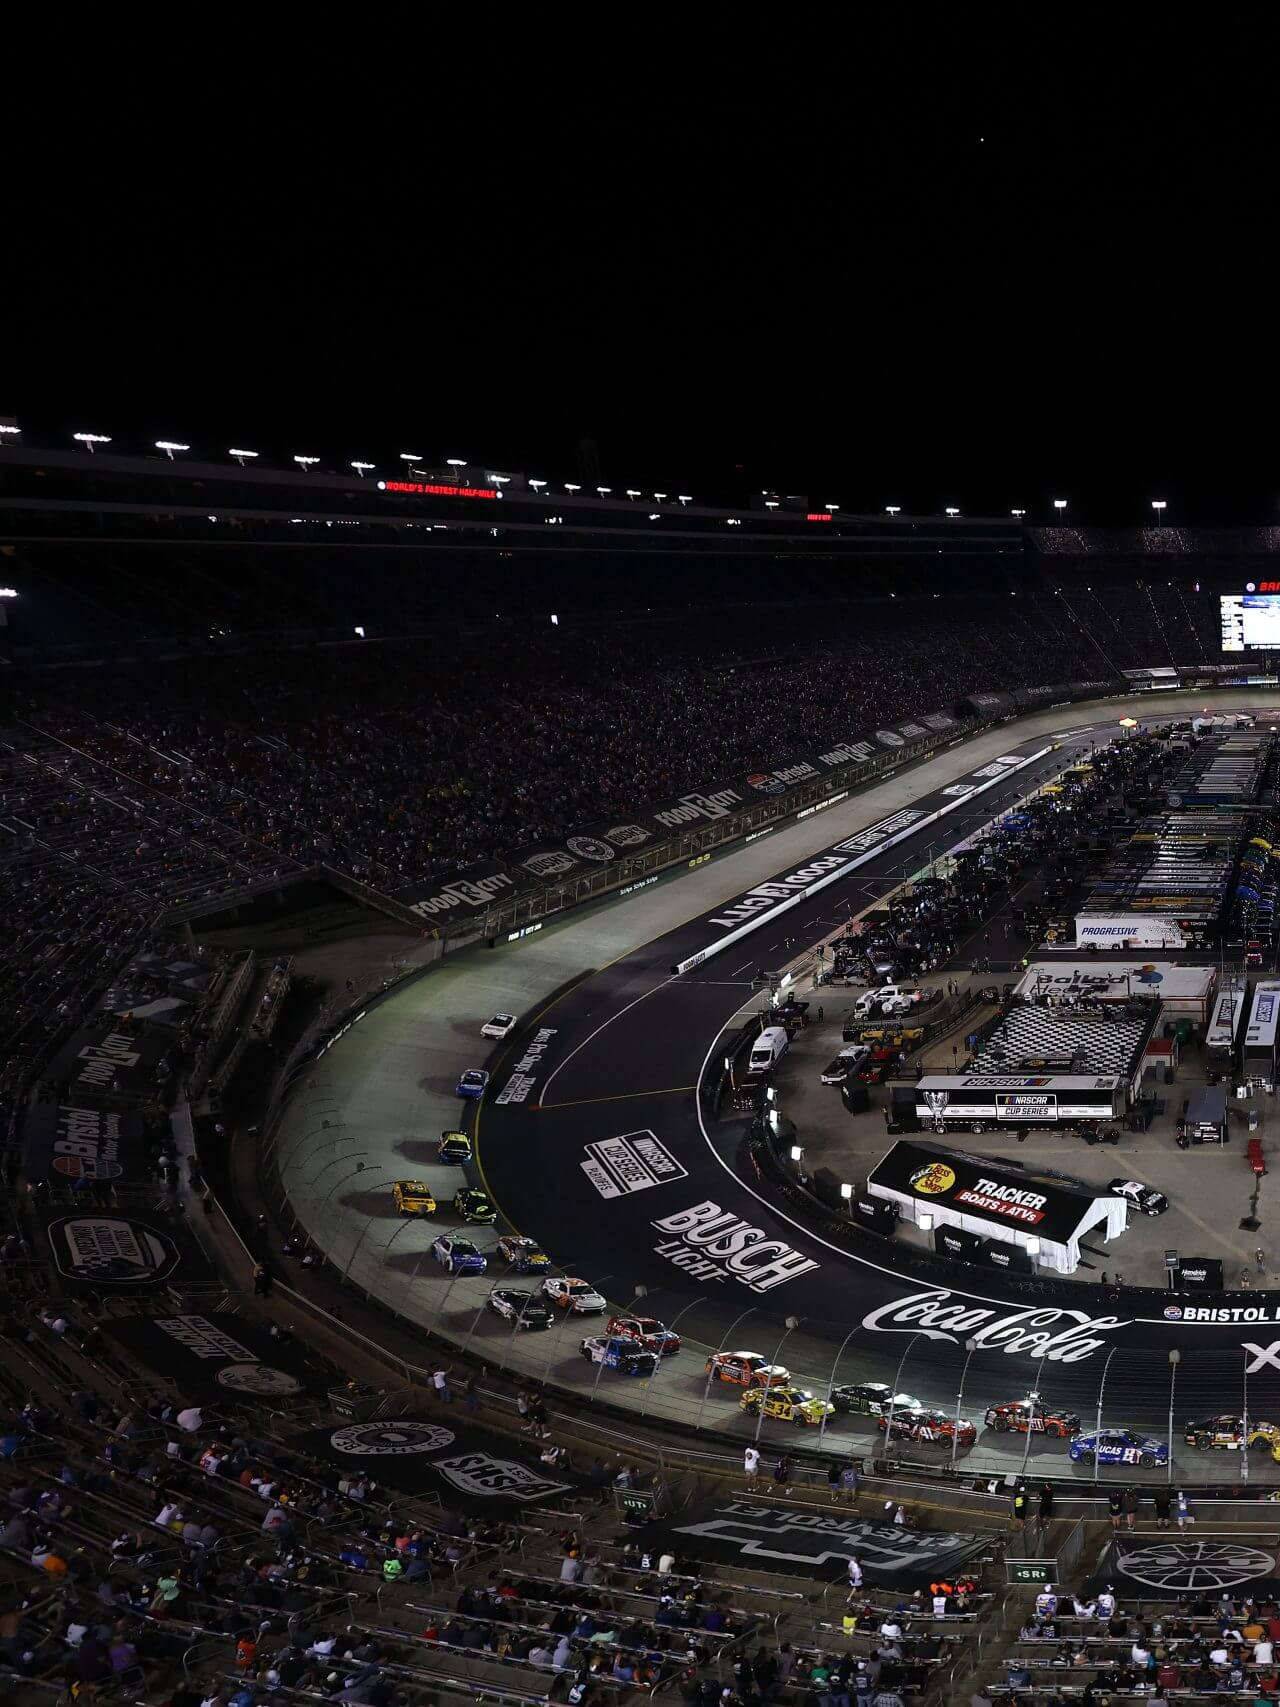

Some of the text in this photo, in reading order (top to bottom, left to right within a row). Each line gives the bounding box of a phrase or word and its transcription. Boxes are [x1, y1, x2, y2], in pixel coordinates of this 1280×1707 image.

[386, 481, 496, 499] WORLD'S FASTEST HALF-MILE
[772, 761, 815, 782] Bristol
[653, 788, 743, 827] FOOD CITY
[407, 872, 514, 918] FOOD CITY
[708, 856, 848, 928] FOOD CITY
[1082, 927, 1139, 935] PROGRESSIVE
[78, 1060, 116, 1087] FOOD
[1005, 1107, 1049, 1115] CUP SERIES
[1014, 1096, 1048, 1105] NASCAR
[56, 1105, 100, 1158] Bristol
[603, 1145, 648, 1182] CUP SERIES
[633, 1139, 677, 1174] NASCAR
[588, 1167, 613, 1191] PLAYOFFS
[927, 1172, 942, 1183] Pro
[934, 1163, 951, 1178] Bass
[920, 1180, 945, 1193] Shops
[971, 1178, 1048, 1210] TRACKER
[959, 1191, 1000, 1212] BOATS
[1006, 1206, 1037, 1222] ATVs
[650, 1200, 821, 1293] BUSCH
[653, 1241, 730, 1281] LIGHT
[1181, 1268, 1207, 1277] Hendrick
[1182, 1306, 1270, 1322] BRISTOL
[862, 1291, 1136, 1364] Coca Cola
[775, 1404, 792, 1417] 34
[920, 1427, 934, 1440] 41
[444, 1456, 556, 1496] BUSH'S
[506, 1464, 533, 1483] BEST
[713, 1502, 967, 1548] CHEVROLET
